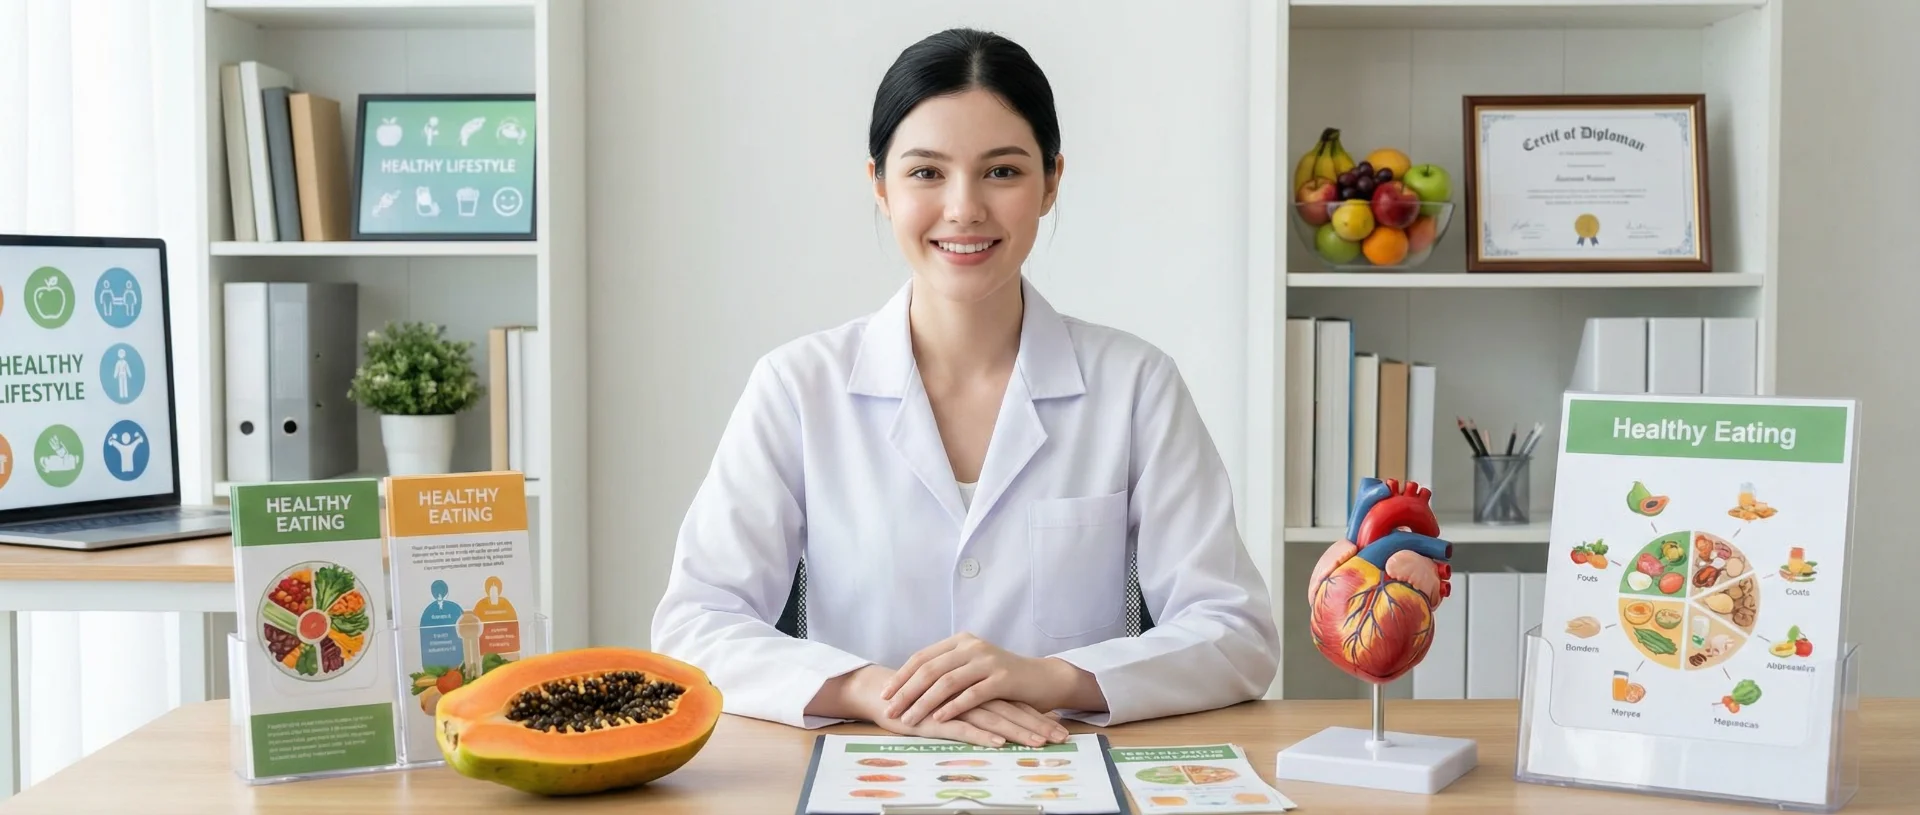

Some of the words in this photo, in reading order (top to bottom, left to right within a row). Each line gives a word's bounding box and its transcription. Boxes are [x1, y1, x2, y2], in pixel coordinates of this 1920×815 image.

[1564, 127, 1576, 140] of
[381, 158, 443, 173] HEALTHY
[446, 158, 516, 173] LIFESTYLE
[0, 354, 83, 376] HEALTHY
[1612, 417, 1707, 446] Healthy
[1714, 420, 1797, 450] Eating
[266, 495, 352, 514] HEALTHY
[418, 487, 500, 506] HEALTHY
[276, 514, 345, 533] EATING
[428, 506, 493, 525] EATING
